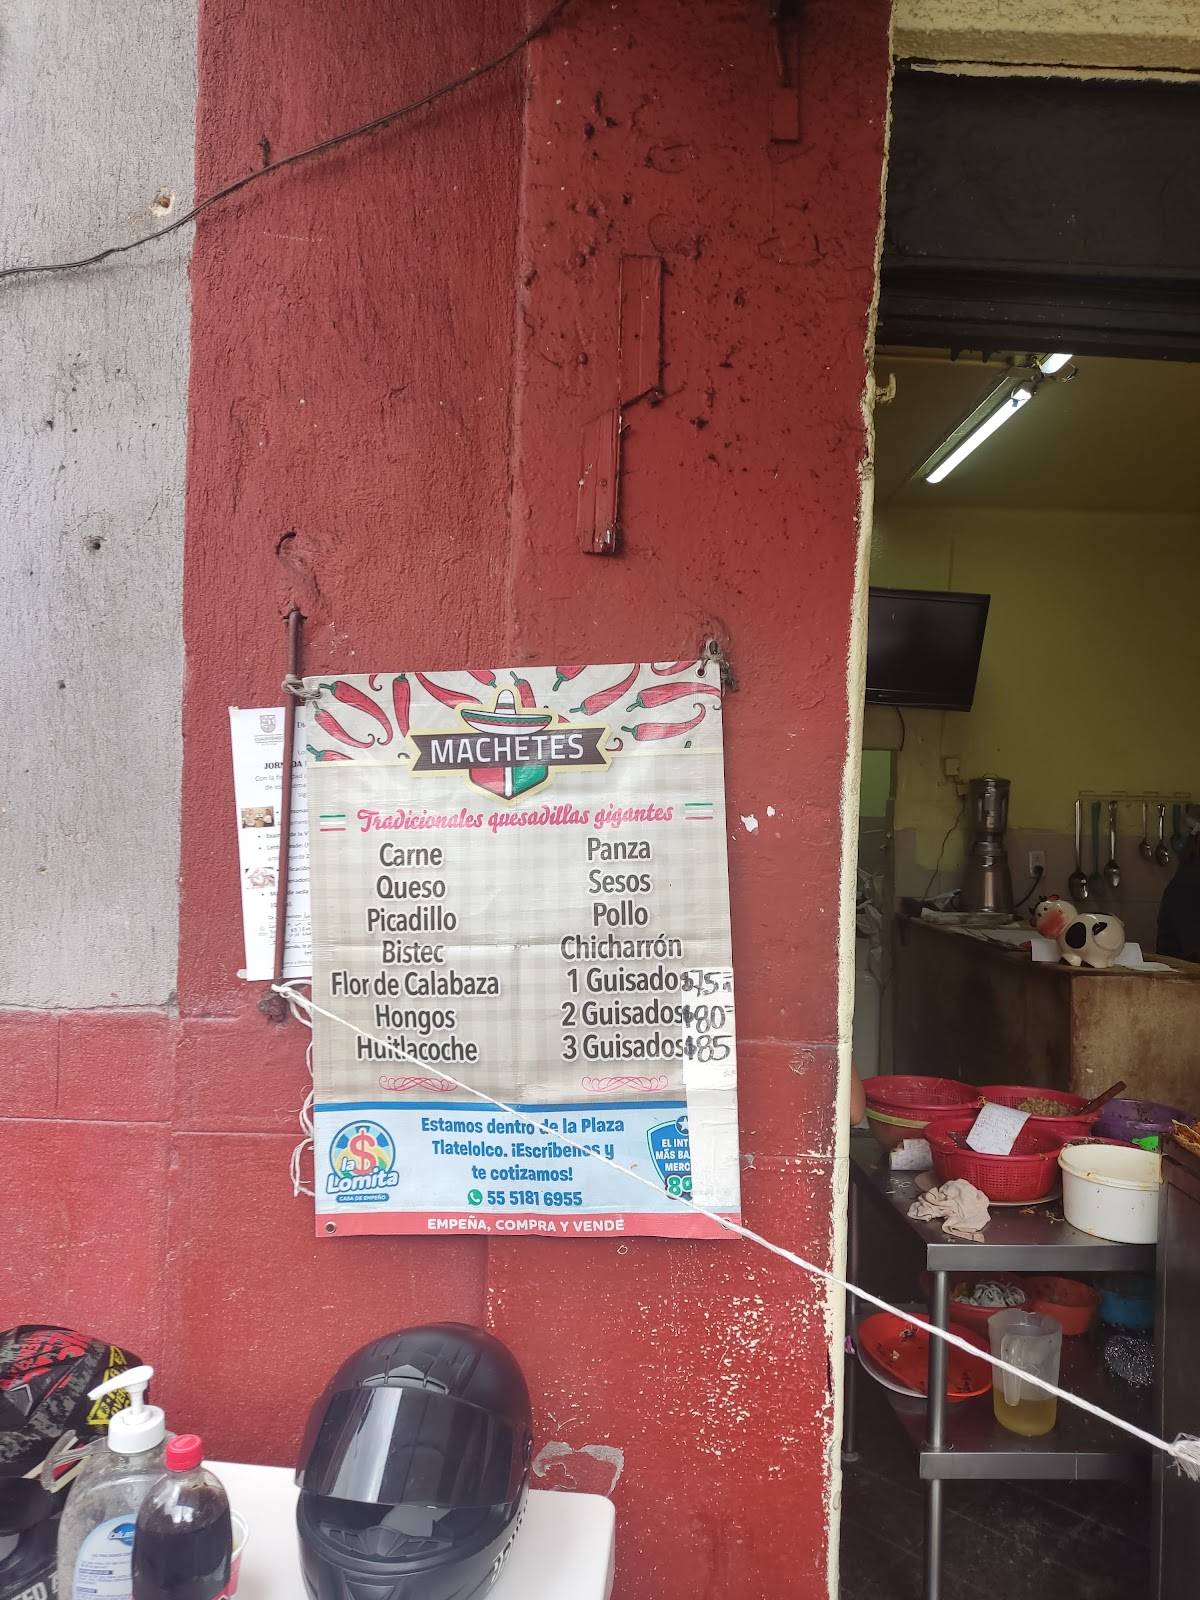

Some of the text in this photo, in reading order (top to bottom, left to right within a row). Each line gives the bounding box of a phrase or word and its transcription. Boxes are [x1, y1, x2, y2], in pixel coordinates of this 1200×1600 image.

[431, 734, 583, 764] MACHETES
[357, 803, 674, 833] Tradicionales quesadillas gigantes
[379, 842, 443, 867] Carne
[587, 837, 651, 860] Panza
[377, 875, 446, 899] Queso
[589, 869, 651, 893] Sesos
[367, 905, 457, 931] Picadillo
[593, 900, 648, 926] Pollo
[382, 940, 444, 963] Bistec
[561, 933, 682, 959] Chicharrón
[331, 970, 499, 995] Flor de Calabaza
[567, 968, 577, 992] 1
[376, 1004, 456, 1035] Hongos
[562, 999, 682, 1026] 2 Guisados
[357, 1035, 478, 1060] Huitlacoche
[562, 1032, 683, 1059] 3 Guisados
[421, 1117, 625, 1134] Estamos dentro de la Plaza
[432, 1140, 508, 1157] Tlatelolco.
[604, 1144, 614, 1160] y
[661, 1139, 689, 1148] EL INT
[678, 1150, 690, 1160] BA
[341, 1156, 356, 1172] la
[472, 1164, 573, 1181] te cotizamos!
[664, 1162, 691, 1172] MERC
[326, 1166, 399, 1194] Lomita
[487, 1190, 583, 1206] 55 5181 6955
[427, 1215, 625, 1232] EMPEÑA, COMPRA Y VENDE
